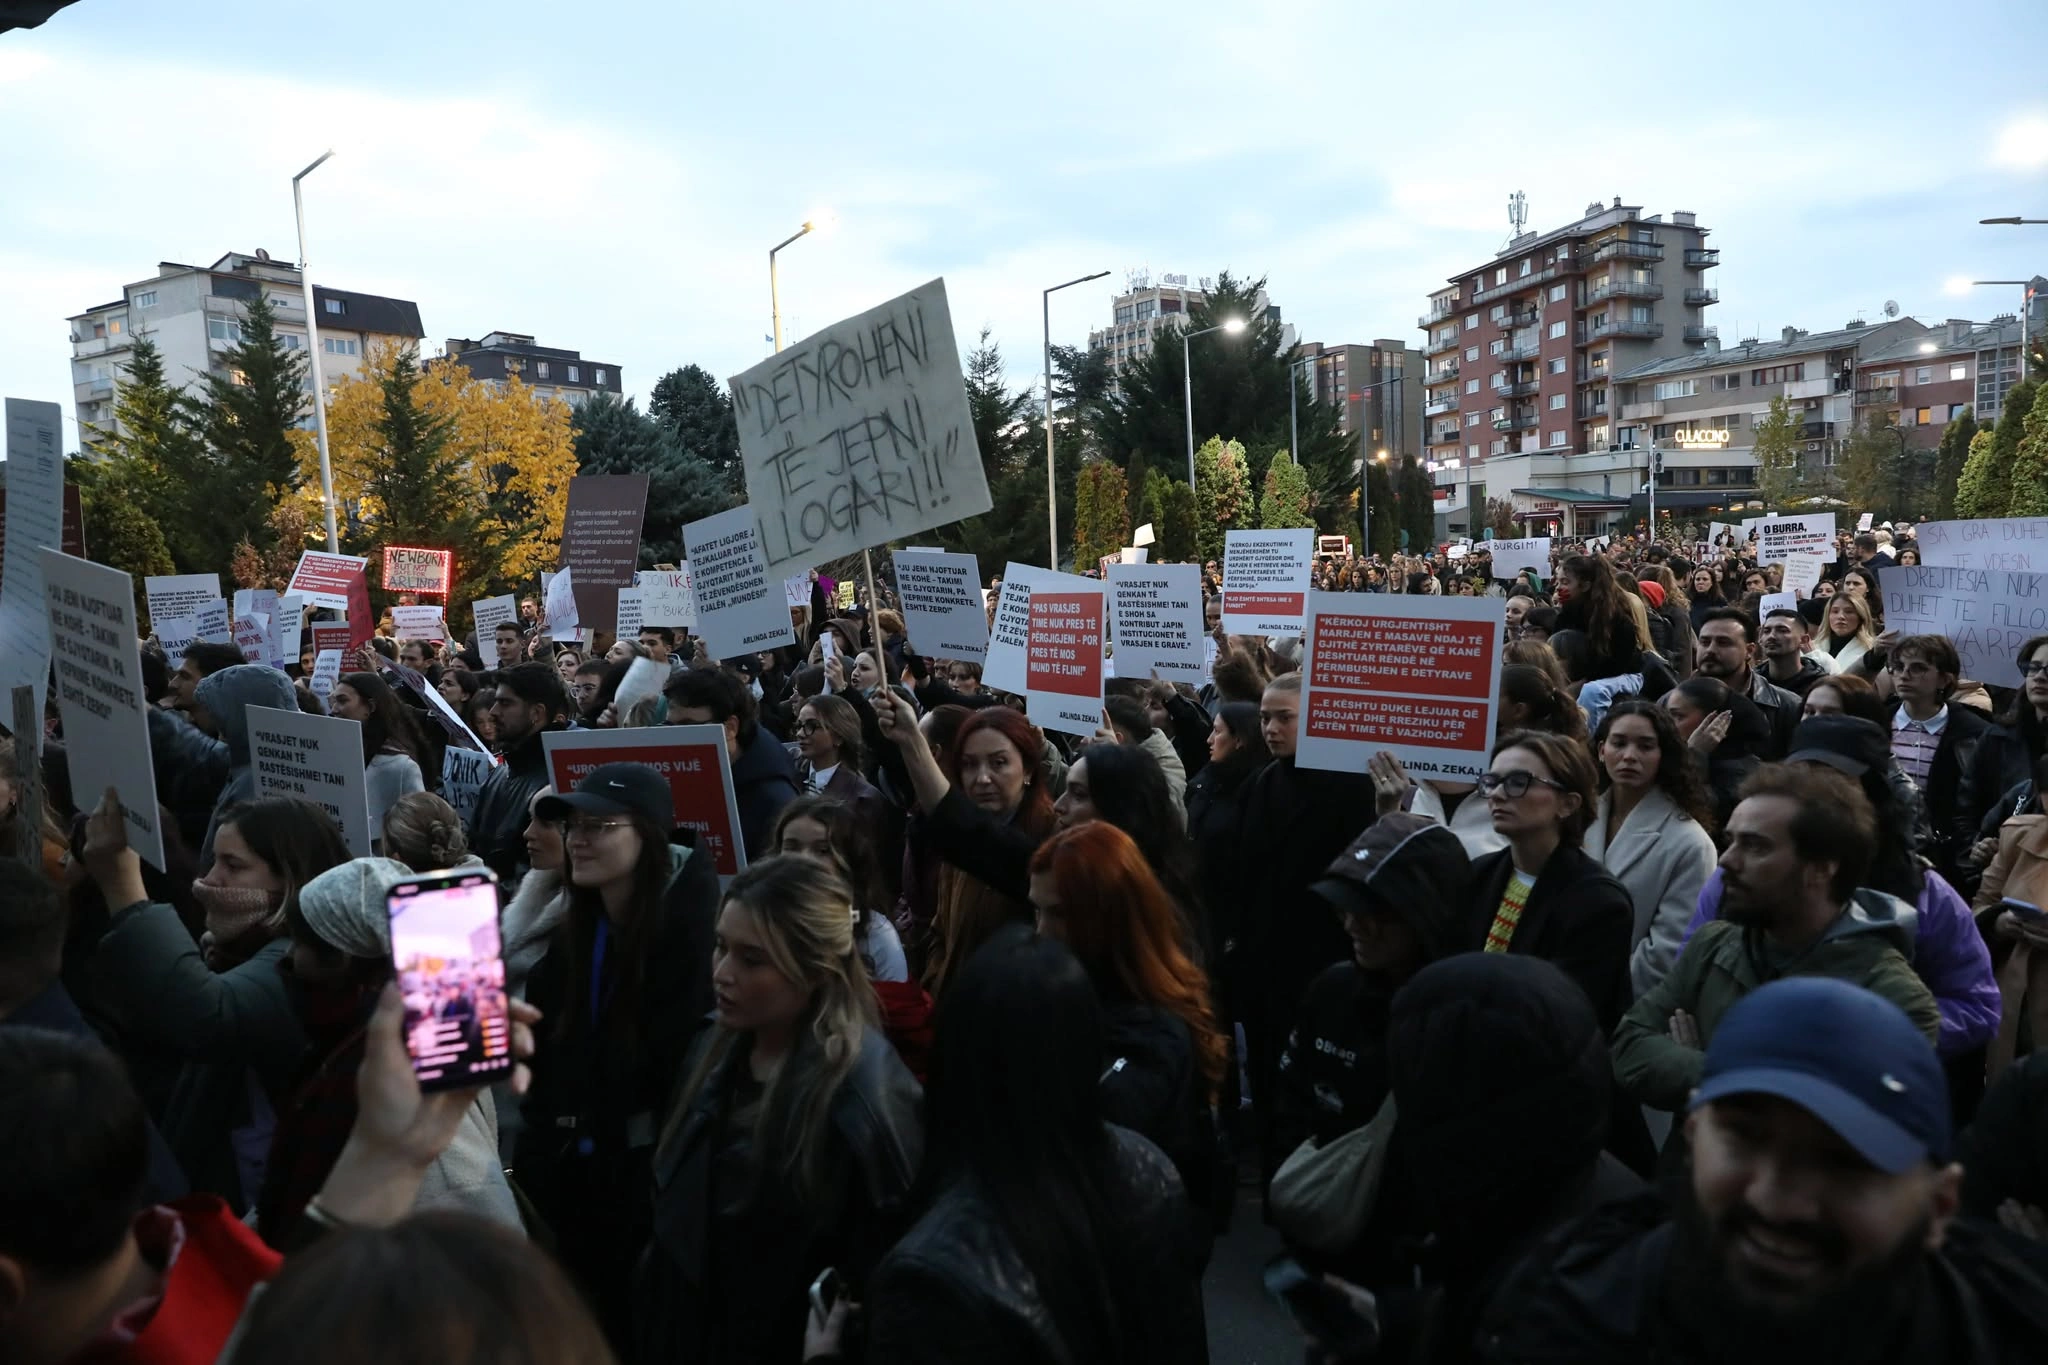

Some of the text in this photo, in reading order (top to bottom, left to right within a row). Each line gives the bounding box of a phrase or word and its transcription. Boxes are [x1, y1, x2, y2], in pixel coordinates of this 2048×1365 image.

[1675, 430, 1729, 442] CULACCINO
[1764, 523, 1807, 533] O BURRA,
[1928, 526, 1950, 544] SA
[1962, 523, 1990, 542] GRA
[720, 531, 748, 547] LIGJORE
[389, 549, 445, 567] NEWBORN
[693, 544, 748, 567] TEJKALUAR DHE
[695, 555, 753, 579] E KOMPETENCA E
[912, 565, 927, 573] JENI
[929, 566, 967, 575] NJOFTUAR
[388, 576, 441, 588] ARLINDA
[697, 568, 751, 590] GJYQTARIT NUK
[937, 577, 962, 585] TAKIMI
[2007, 574, 2042, 598] NUK
[903, 594, 934, 603] VEPRIME
[1149, 590, 1157, 598] TË
[1050, 603, 1080, 613] VRASJES
[1891, 593, 1943, 616] DUHET
[1952, 599, 1976, 621] TE
[1032, 618, 1096, 630] TIME NUK PRES TË
[1372, 619, 1452, 631] URGJENTISHT
[743, 628, 788, 644] ARLINDA ZEKAJ
[1082, 636, 1098, 646] POR
[1177, 631, 1186, 639] NË
[1319, 629, 1483, 645] MARRJEN E MASAVE NDAJ TË
[965, 645, 982, 653] ZEKAJ
[1121, 640, 1152, 648] VRASJEN
[1319, 640, 1481, 656] GJITHË ZYRTARËVE QË KANË
[1031, 648, 1075, 660] PRES TË MOS
[1379, 654, 1416, 664] RËNDË
[1420, 656, 1435, 665] NË
[1031, 662, 1050, 674] MUND
[1052, 663, 1060, 675] TË
[1401, 667, 1408, 676] E
[1412, 668, 1472, 680] DETYRAVE
[1316, 673, 1370, 685] TË TYRE...
[1333, 700, 1377, 711] KËSHTU
[1381, 702, 1411, 713] DUKE
[1415, 704, 1459, 717] LEJUAR
[1463, 707, 1478, 718] QË
[1060, 711, 1098, 724] ARLINDA ZEKAJ
[1313, 710, 1360, 721] PASOJAT
[1364, 713, 1385, 723] DHE
[1389, 715, 1439, 727] RREZIKU
[1312, 721, 1346, 732] JETËN
[1350, 724, 1376, 734] TIME
[1380, 726, 1392, 735] TË
[300, 737, 319, 750] NUK
[258, 746, 306, 763] QENKAN TË
[1399, 761, 1483, 776] LINDA ZEKAJ
[261, 776, 305, 794] E SHOH SA
[323, 772, 344, 786] TANI
